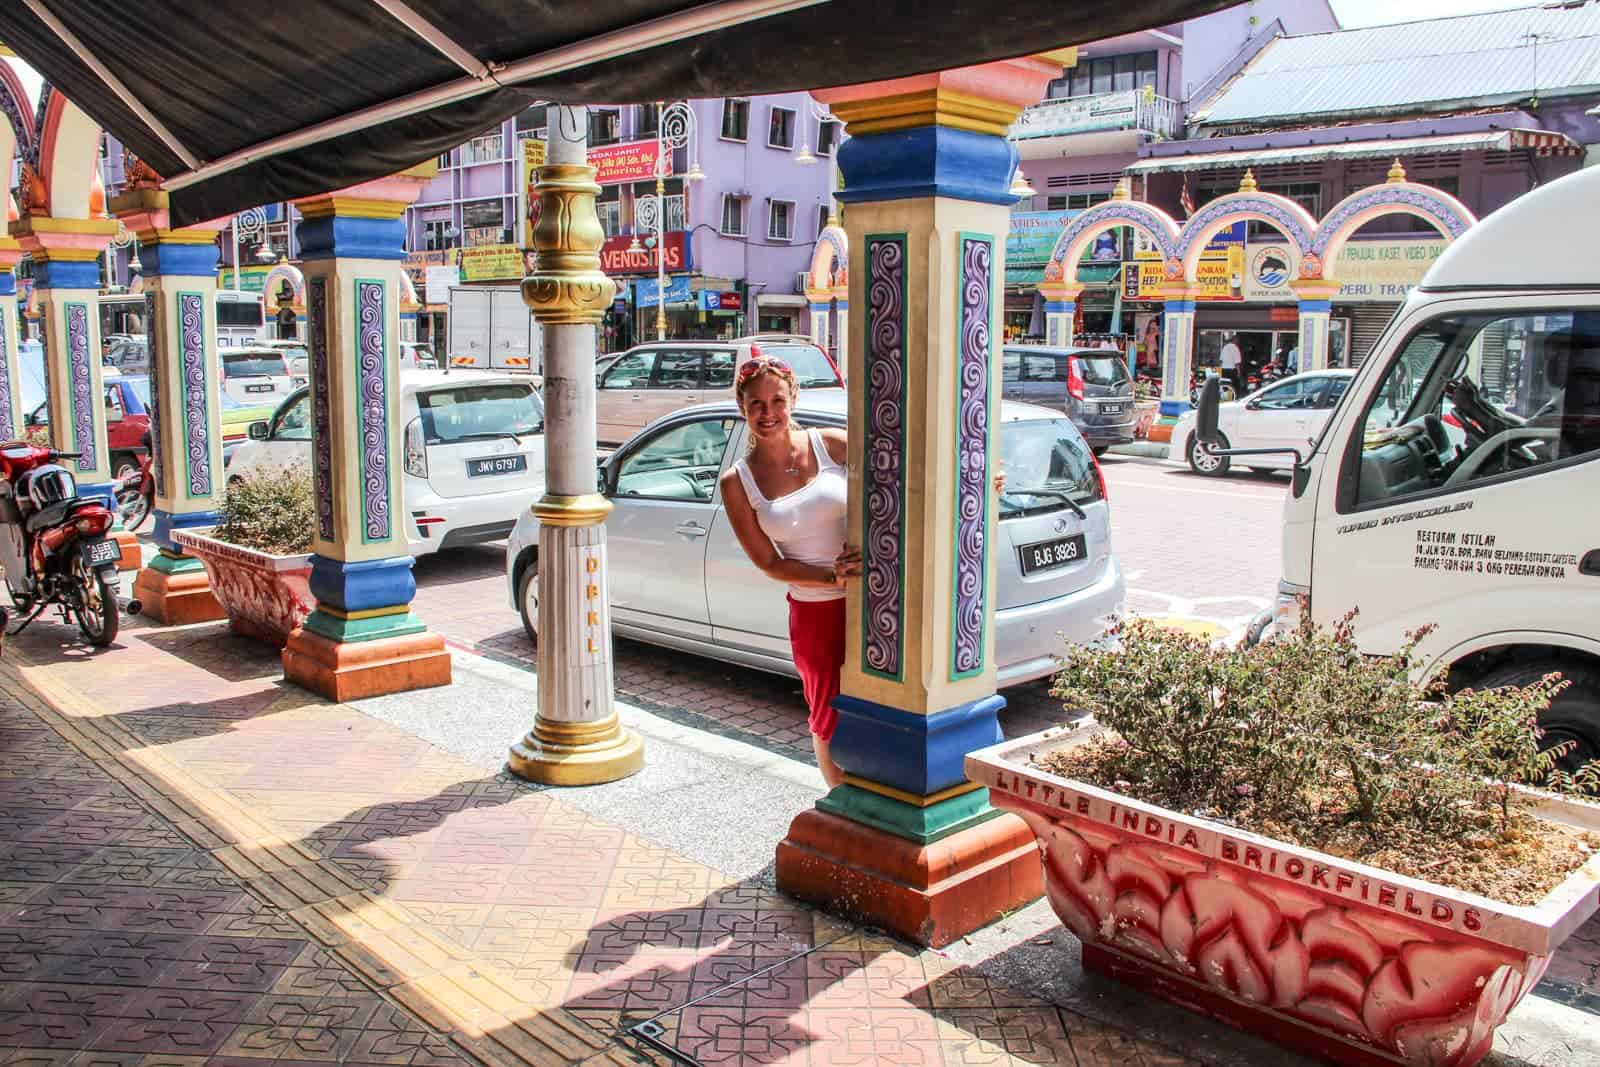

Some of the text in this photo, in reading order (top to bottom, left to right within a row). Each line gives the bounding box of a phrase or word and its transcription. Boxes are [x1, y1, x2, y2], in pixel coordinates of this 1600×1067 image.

[496, 458, 517, 471] 6797
[1381, 501, 1474, 526] INTERCOOLER
[1417, 530, 1496, 546] RESTORAN ISTILAH
[1034, 541, 1077, 567] BJG 3929
[996, 771, 1482, 932] LITTLE INDIA BRICKFIELDS
